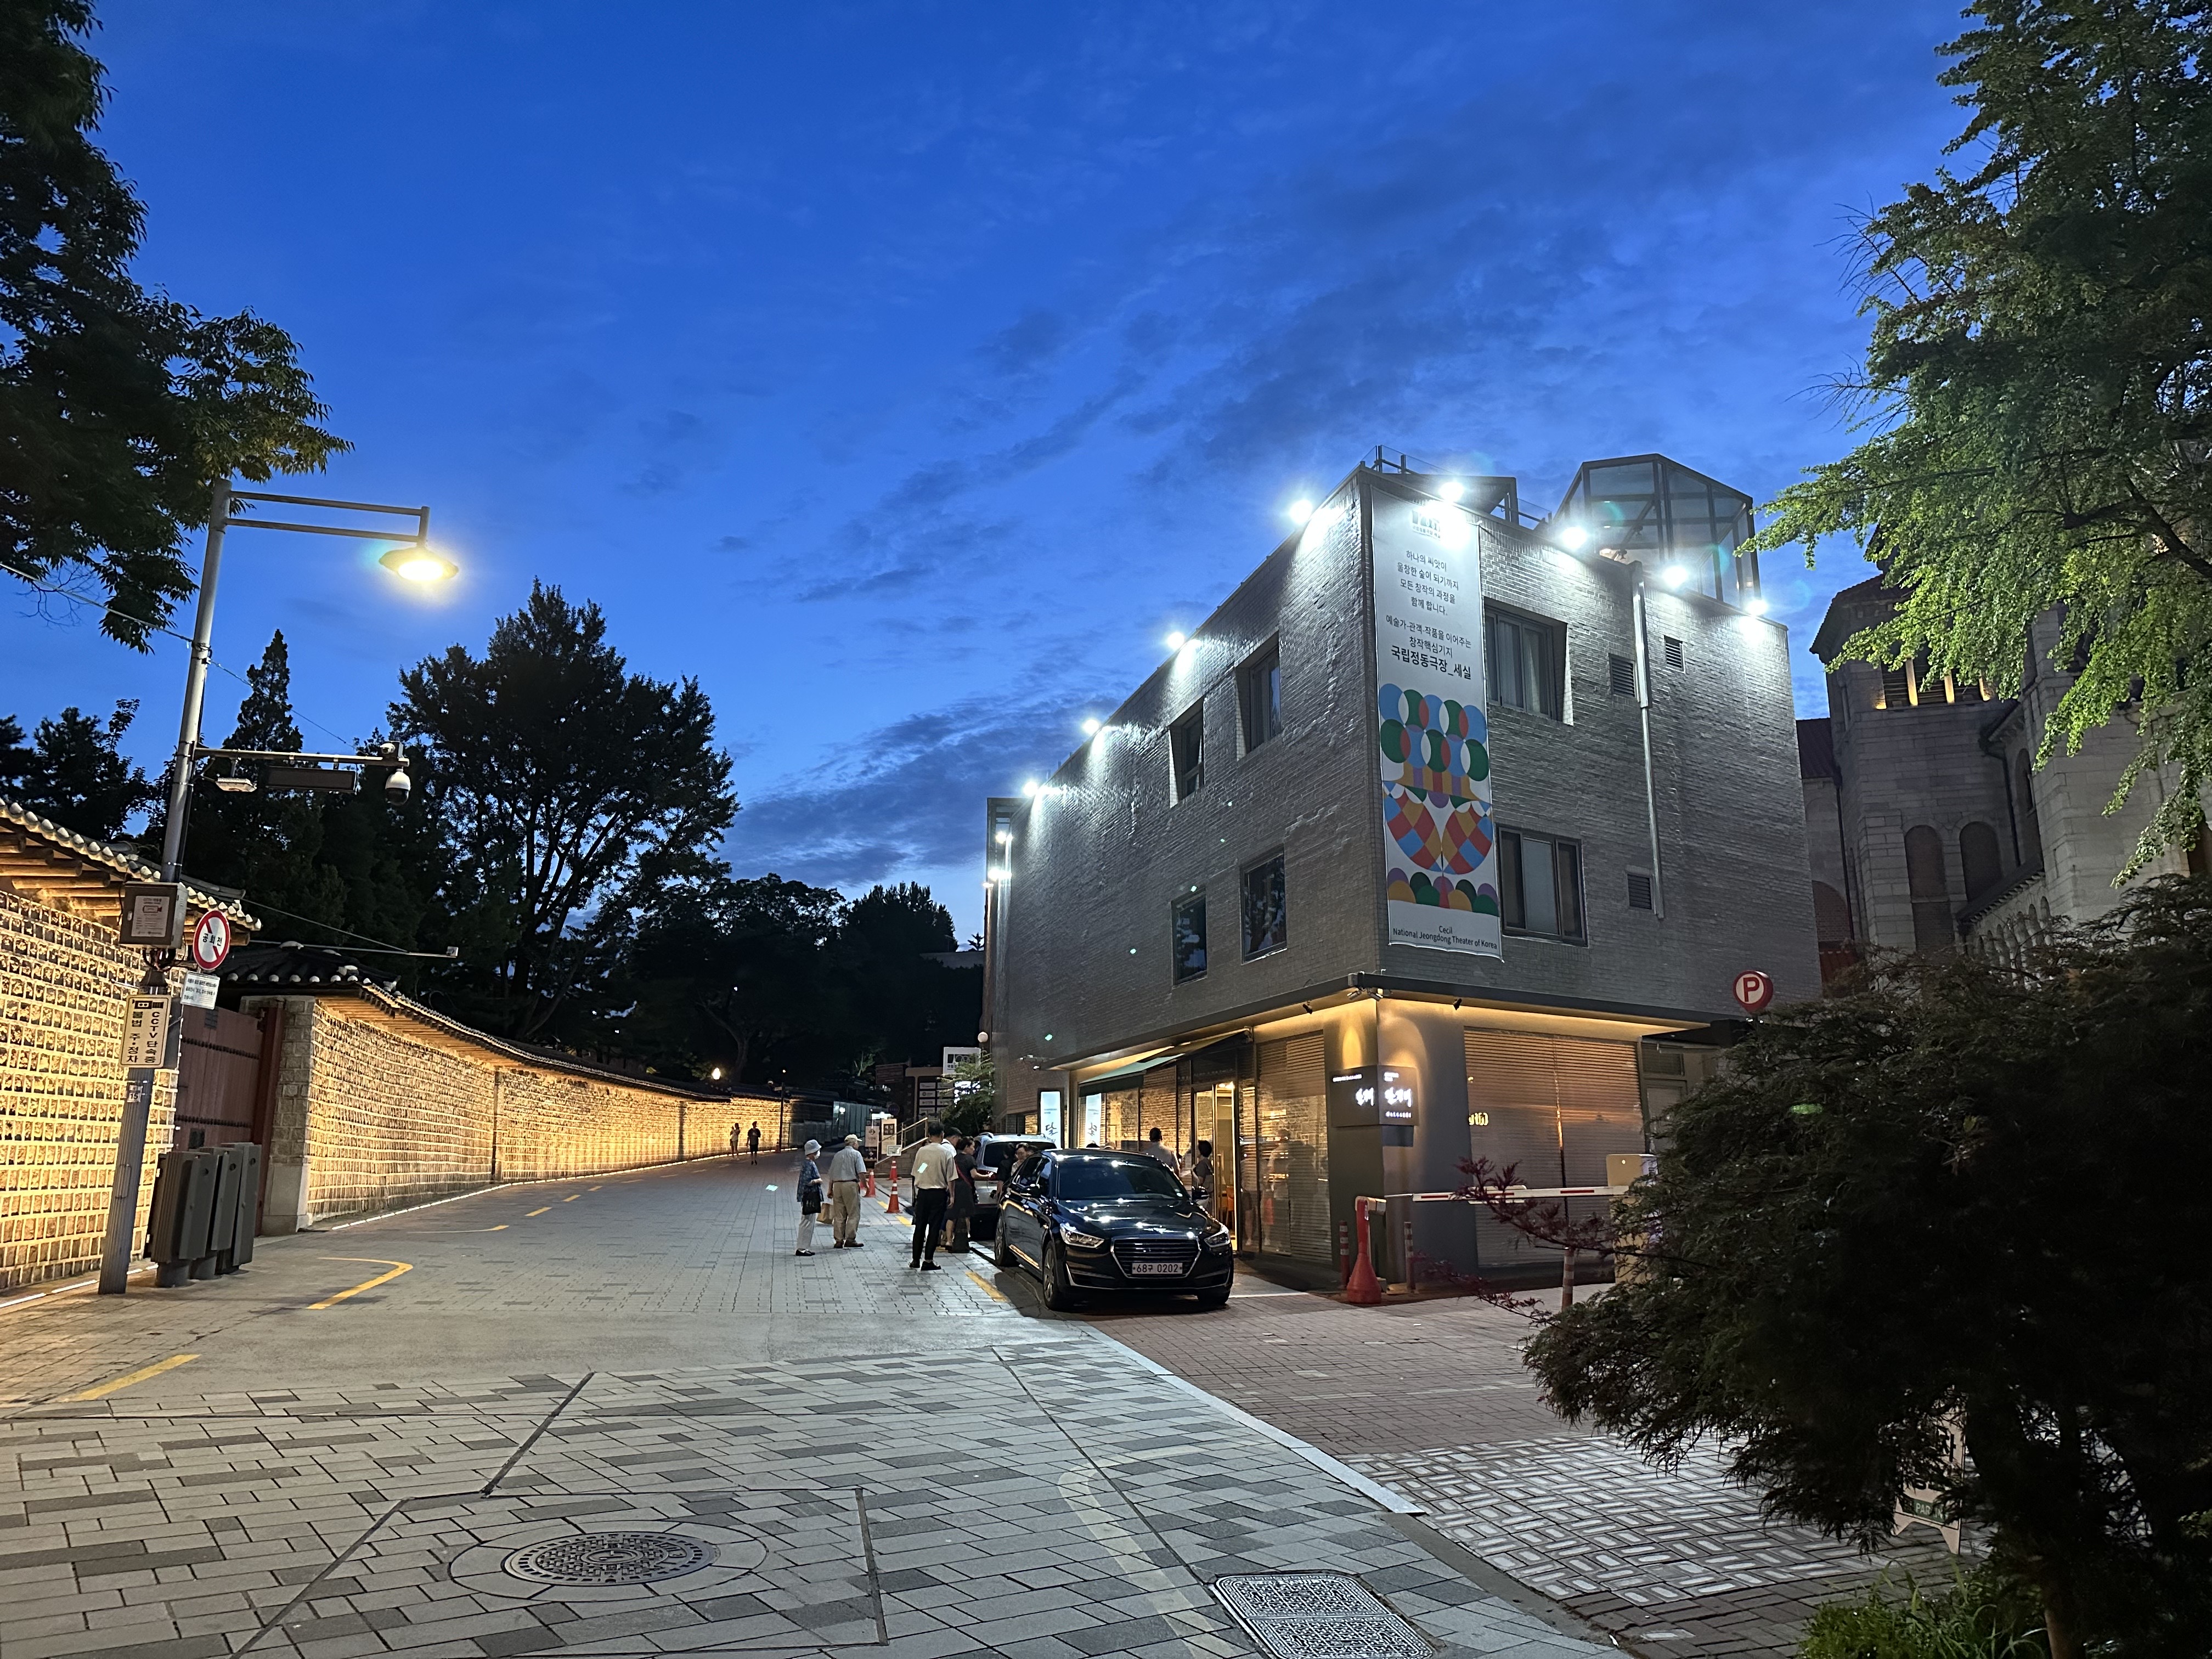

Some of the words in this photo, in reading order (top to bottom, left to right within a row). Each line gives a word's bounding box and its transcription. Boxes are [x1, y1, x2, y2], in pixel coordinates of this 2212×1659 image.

[1406, 550, 1425, 565] 하나의
[1427, 557, 1447, 572] 씨앗이
[1397, 562, 1417, 577] 울창한
[1419, 569, 1431, 581] 숲이
[1434, 574, 1459, 591] 되기까지
[1400, 579, 1413, 590] 모든
[1415, 583, 1434, 597] 창작의
[1436, 590, 1455, 604] 과정을
[1411, 596, 1424, 610] 함께
[1426, 601, 1448, 616] 합니다.
[1409, 636, 1453, 658] 창작핵심기지
[1446, 633, 1471, 648] 이어주는
[203, 933, 222, 946] 공회전
[1393, 928, 1418, 939] National
[1419, 932, 1451, 945] Jeongdong
[1452, 936, 1473, 945] Theater
[1481, 940, 1497, 949] Korea
[1439, 926, 1453, 934] Cecil
[1743, 977, 1759, 1002] P
[1137, 1264, 1153, 1273] 68구
[1157, 1264, 1178, 1273] 0202
[1915, 1503, 1948, 1519] PARIN
